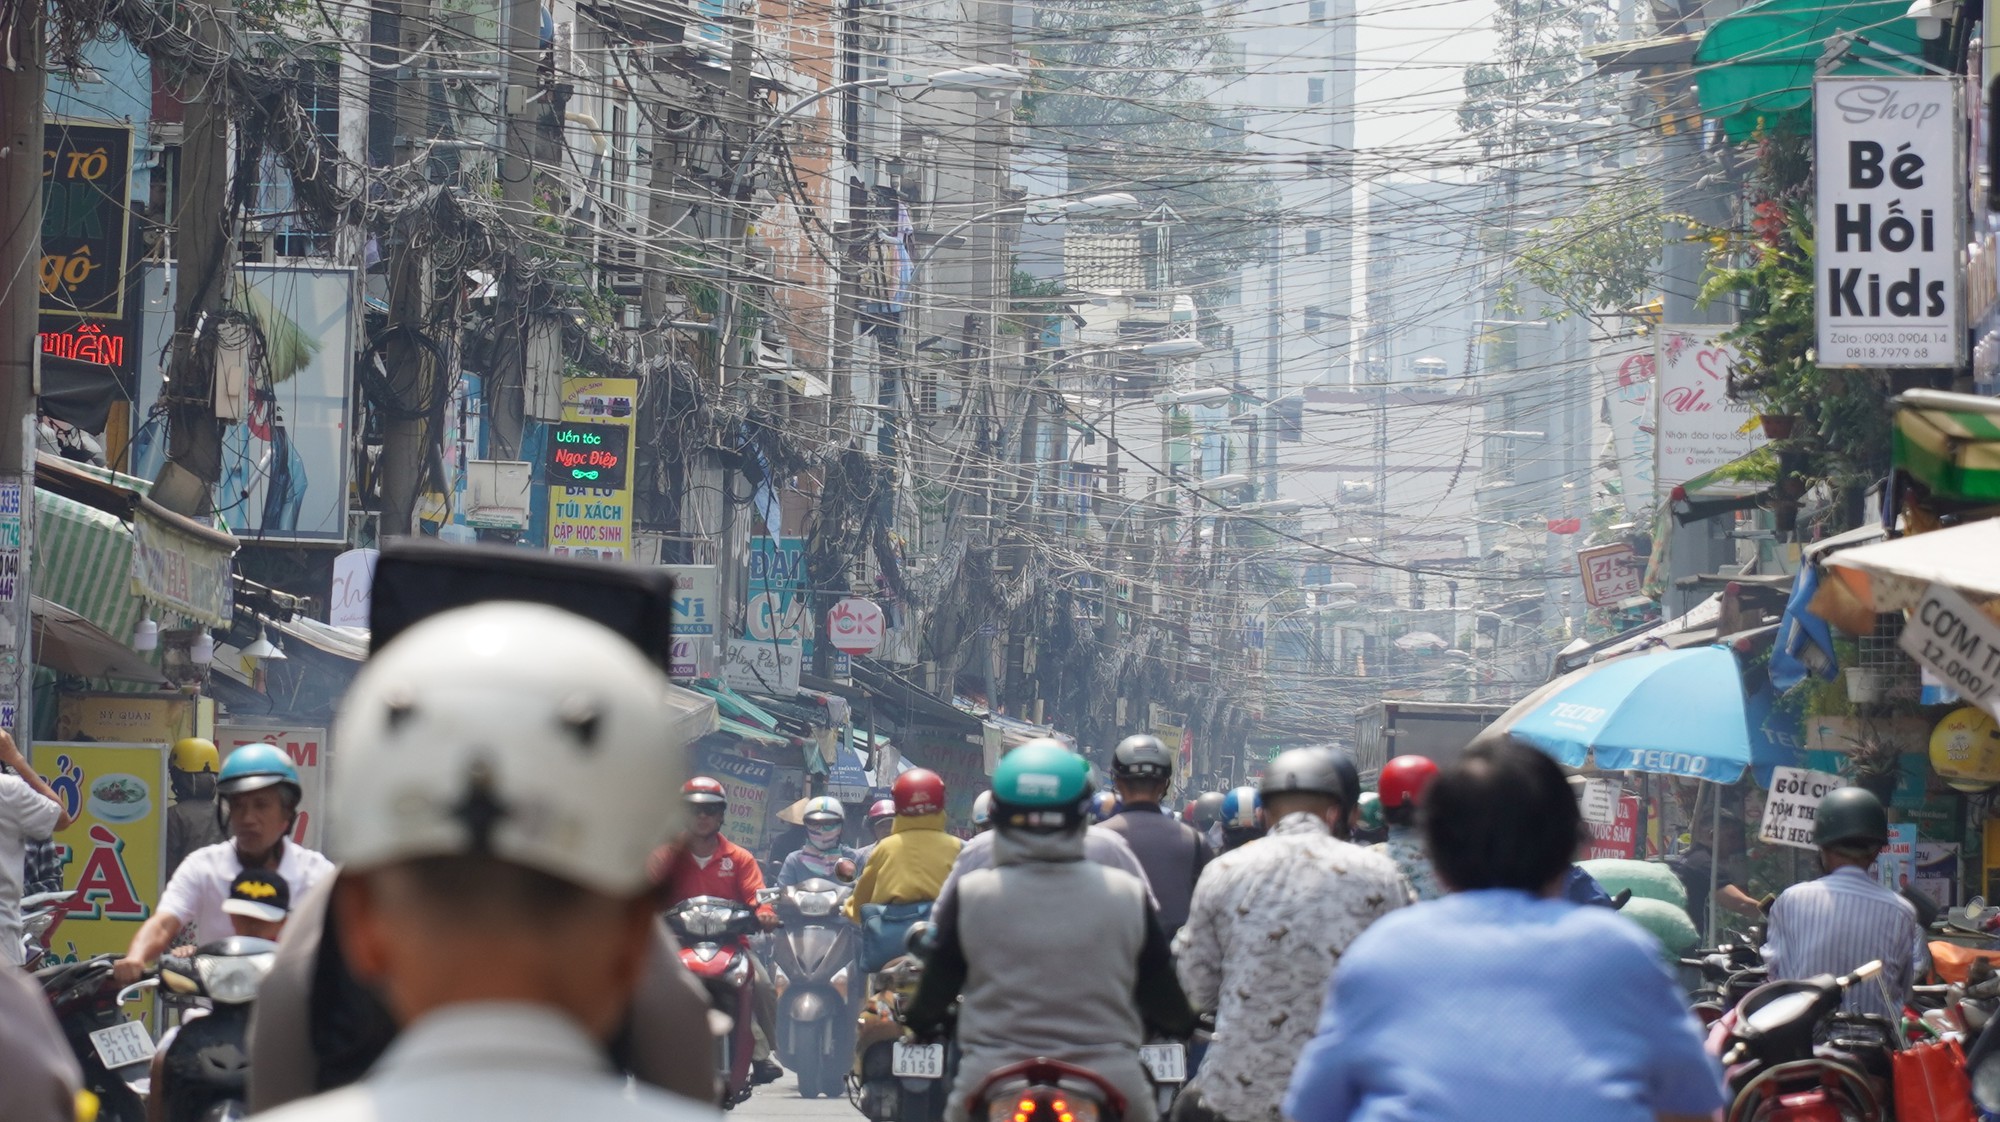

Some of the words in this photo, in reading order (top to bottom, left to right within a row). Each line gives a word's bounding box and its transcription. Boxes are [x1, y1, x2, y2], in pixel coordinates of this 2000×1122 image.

[1834, 85, 1940, 128] Shop
[67, 147, 107, 180] TÔ
[1848, 141, 1925, 190] Bé
[1828, 267, 1946, 318] Kids
[583, 433, 602, 445] tóc
[555, 448, 588, 468] Ngọc
[589, 449, 618, 469] Điệp
[556, 500, 579, 519] TÚI
[584, 501, 622, 520] XÁCH
[598, 526, 622, 542] SINH
[1920, 598, 1981, 659] CƠM
[1550, 702, 1606, 723] TECNO
[1630, 749, 1707, 773] TECNO
[900, 1060, 935, 1073] 8159
